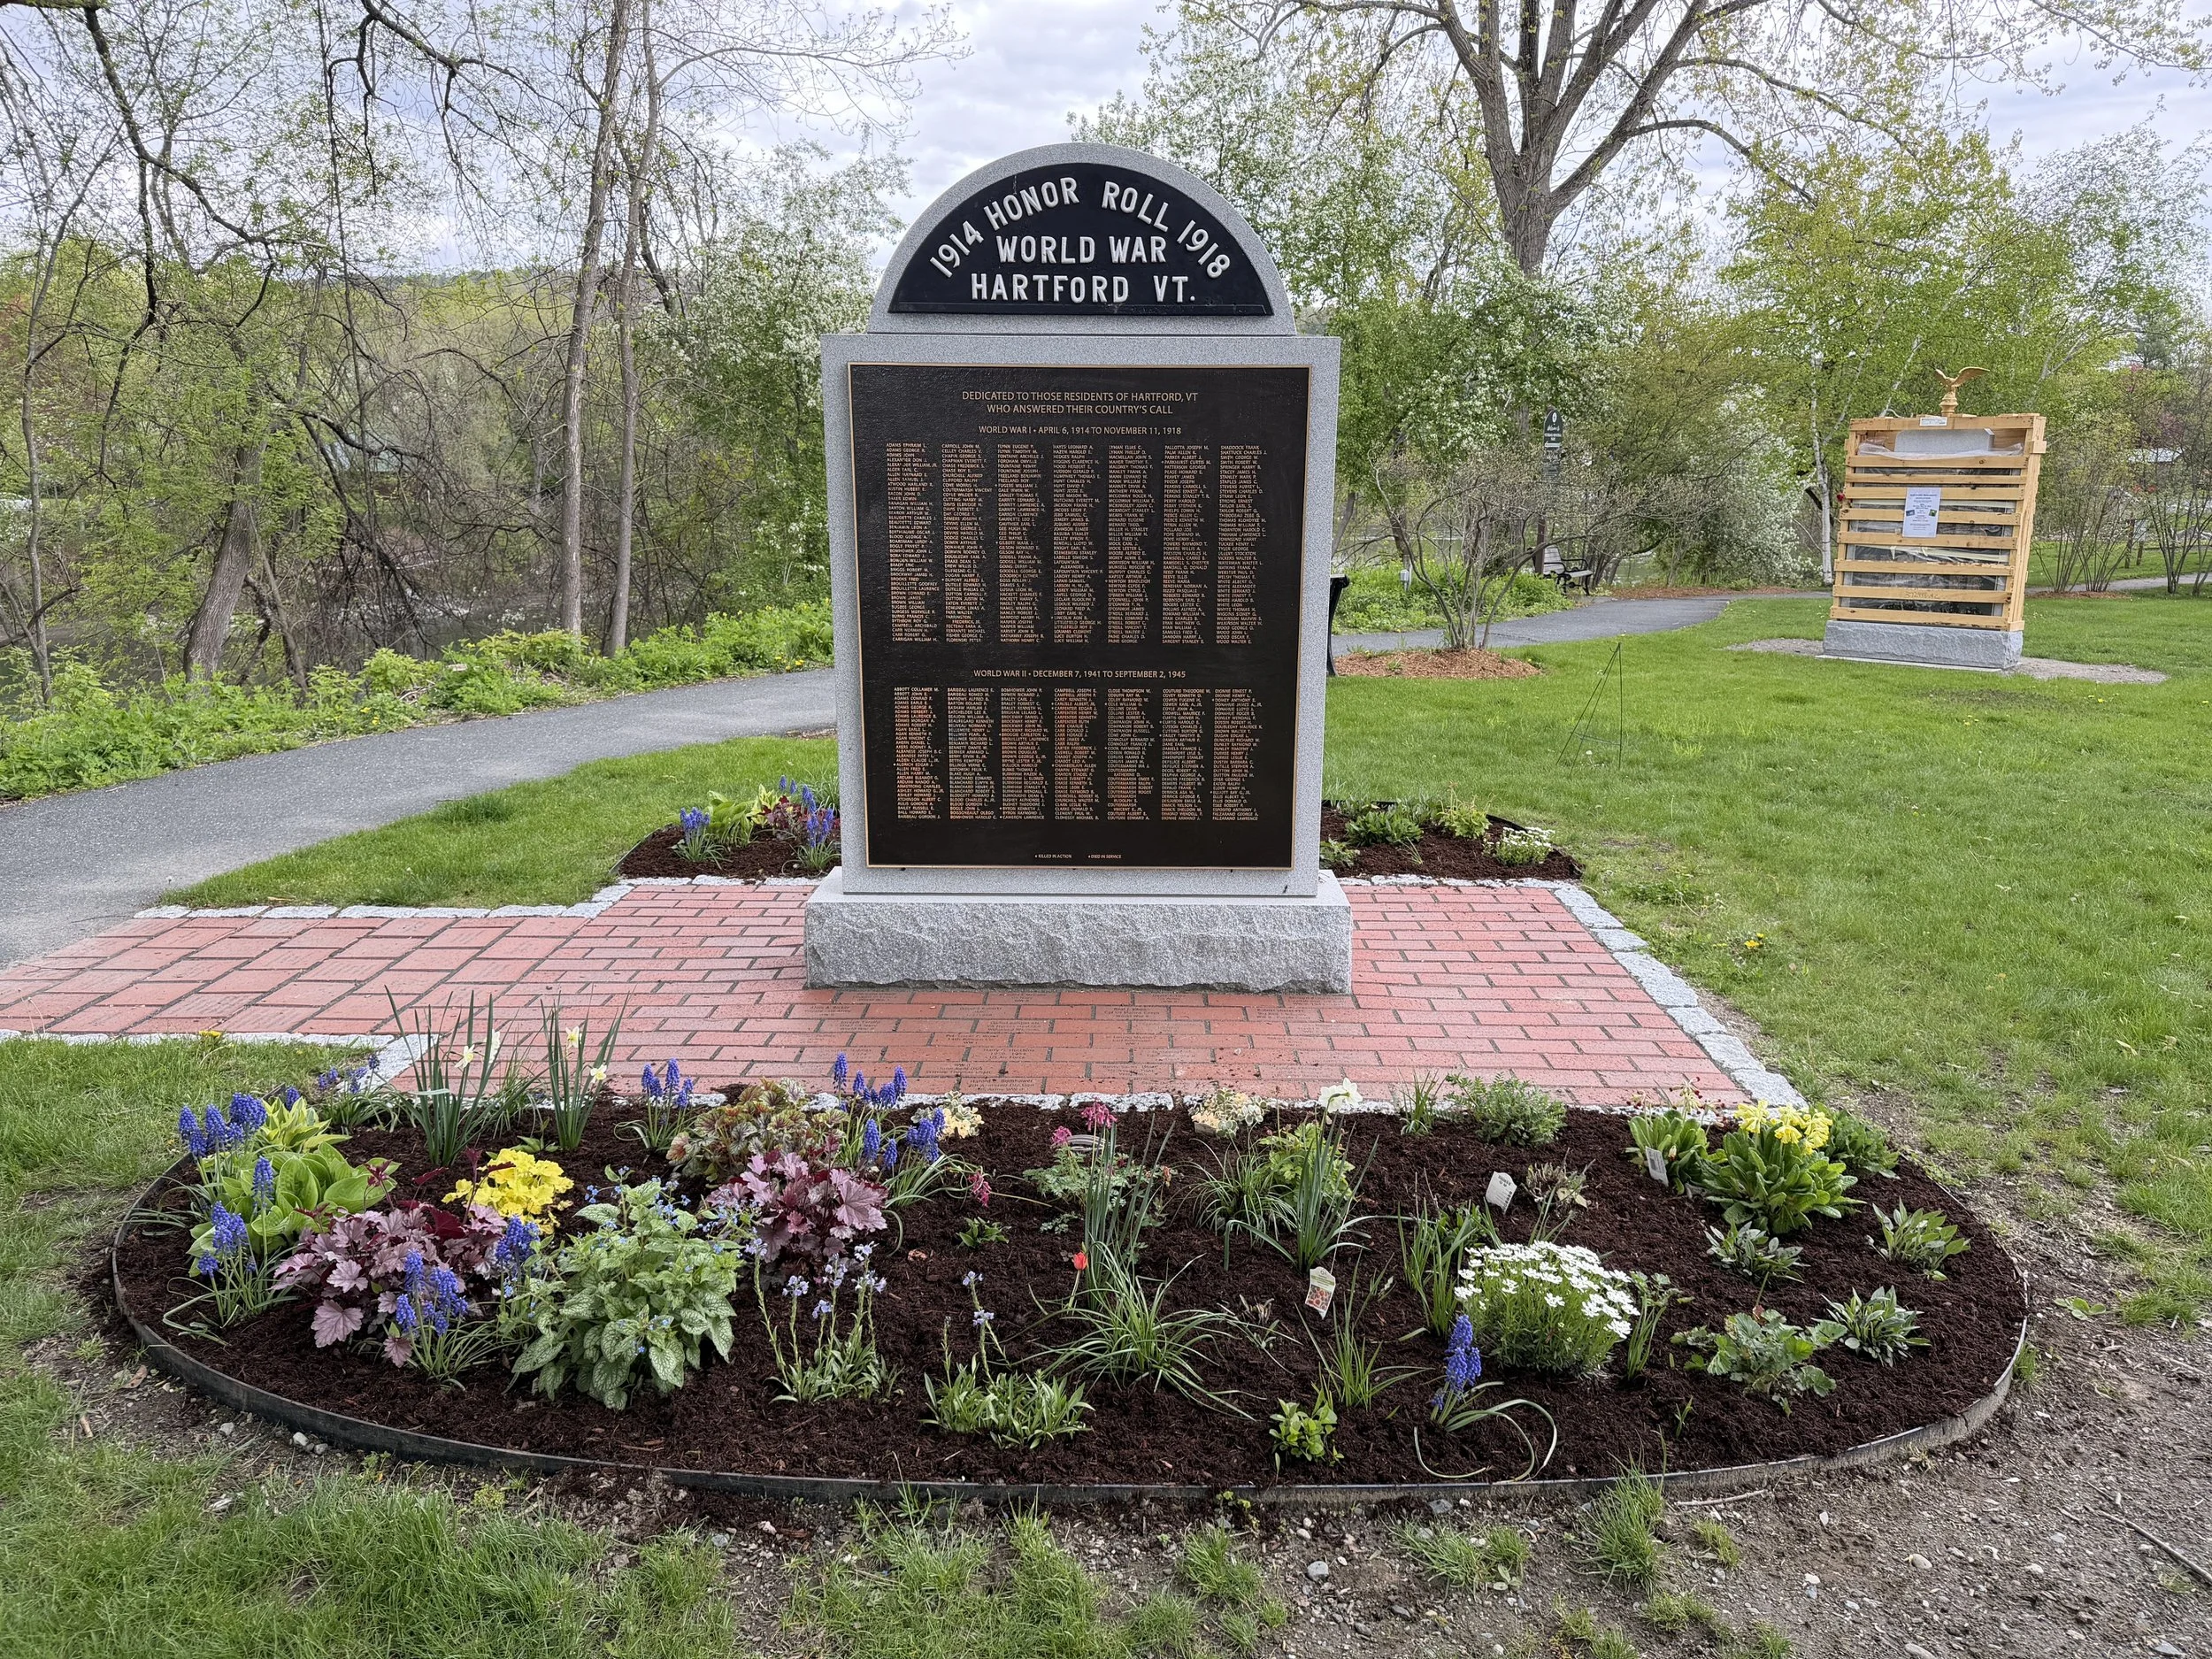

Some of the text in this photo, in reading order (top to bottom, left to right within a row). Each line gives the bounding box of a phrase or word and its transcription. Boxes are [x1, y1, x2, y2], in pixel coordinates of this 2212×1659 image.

[929, 176, 1230, 279] 1914 HONOR ROLL 1918
[995, 235, 1166, 264] WORLD WAR
[971, 273, 1196, 303] HARTFORD VT.
[962, 391, 1198, 403] DEDICATED TO THOSE RESIDENTS OF HARTFORD, VT
[987, 404, 1010, 413] WHO
[1012, 404, 1064, 414] ANSWERED
[1066, 405, 1093, 414] THEIR
[1149, 405, 1172, 414] CALL
[1038, 426, 1060, 434] APRIL
[1061, 426, 1069, 435] 6,
[1149, 426, 1160, 435] 11,
[1074, 670, 1081, 679] 7,
[1115, 670, 1157, 679] SEPTEMBER
